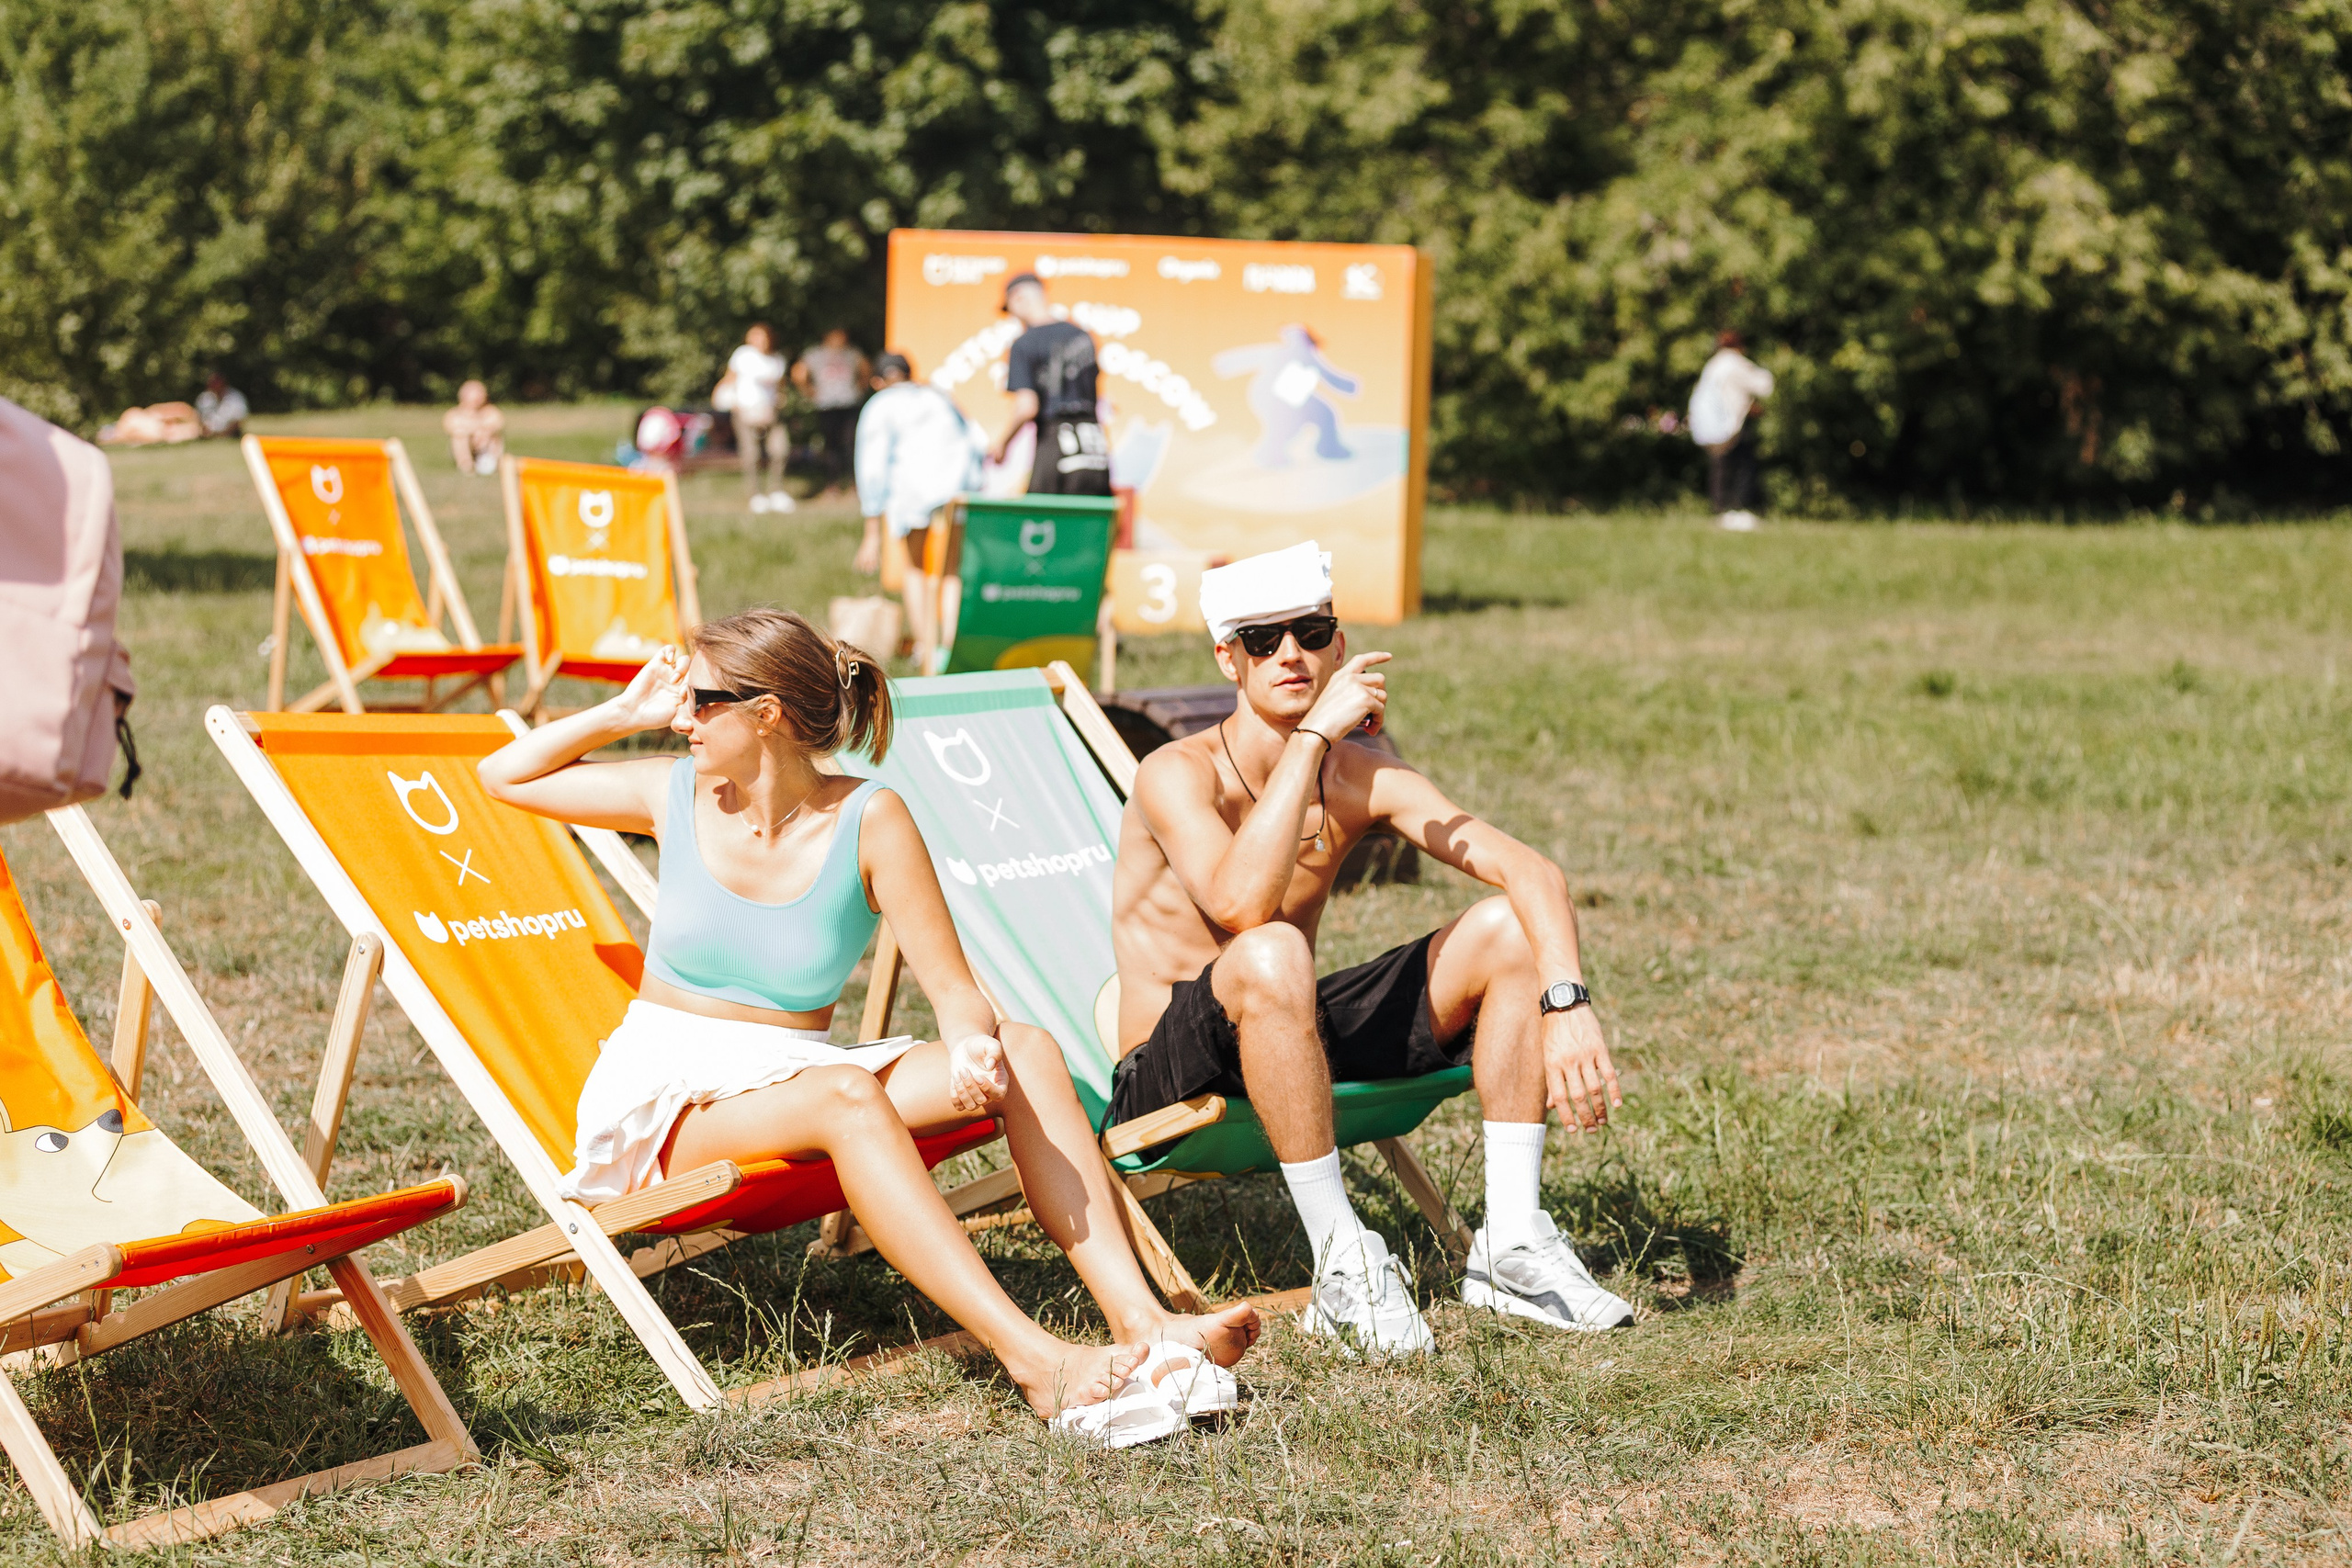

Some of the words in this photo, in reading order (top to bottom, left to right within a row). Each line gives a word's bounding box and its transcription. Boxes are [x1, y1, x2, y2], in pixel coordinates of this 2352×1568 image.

[1137, 562, 1178, 624] 3
[977, 843, 1113, 888] petshopru
[447, 908, 587, 947] petshopru
